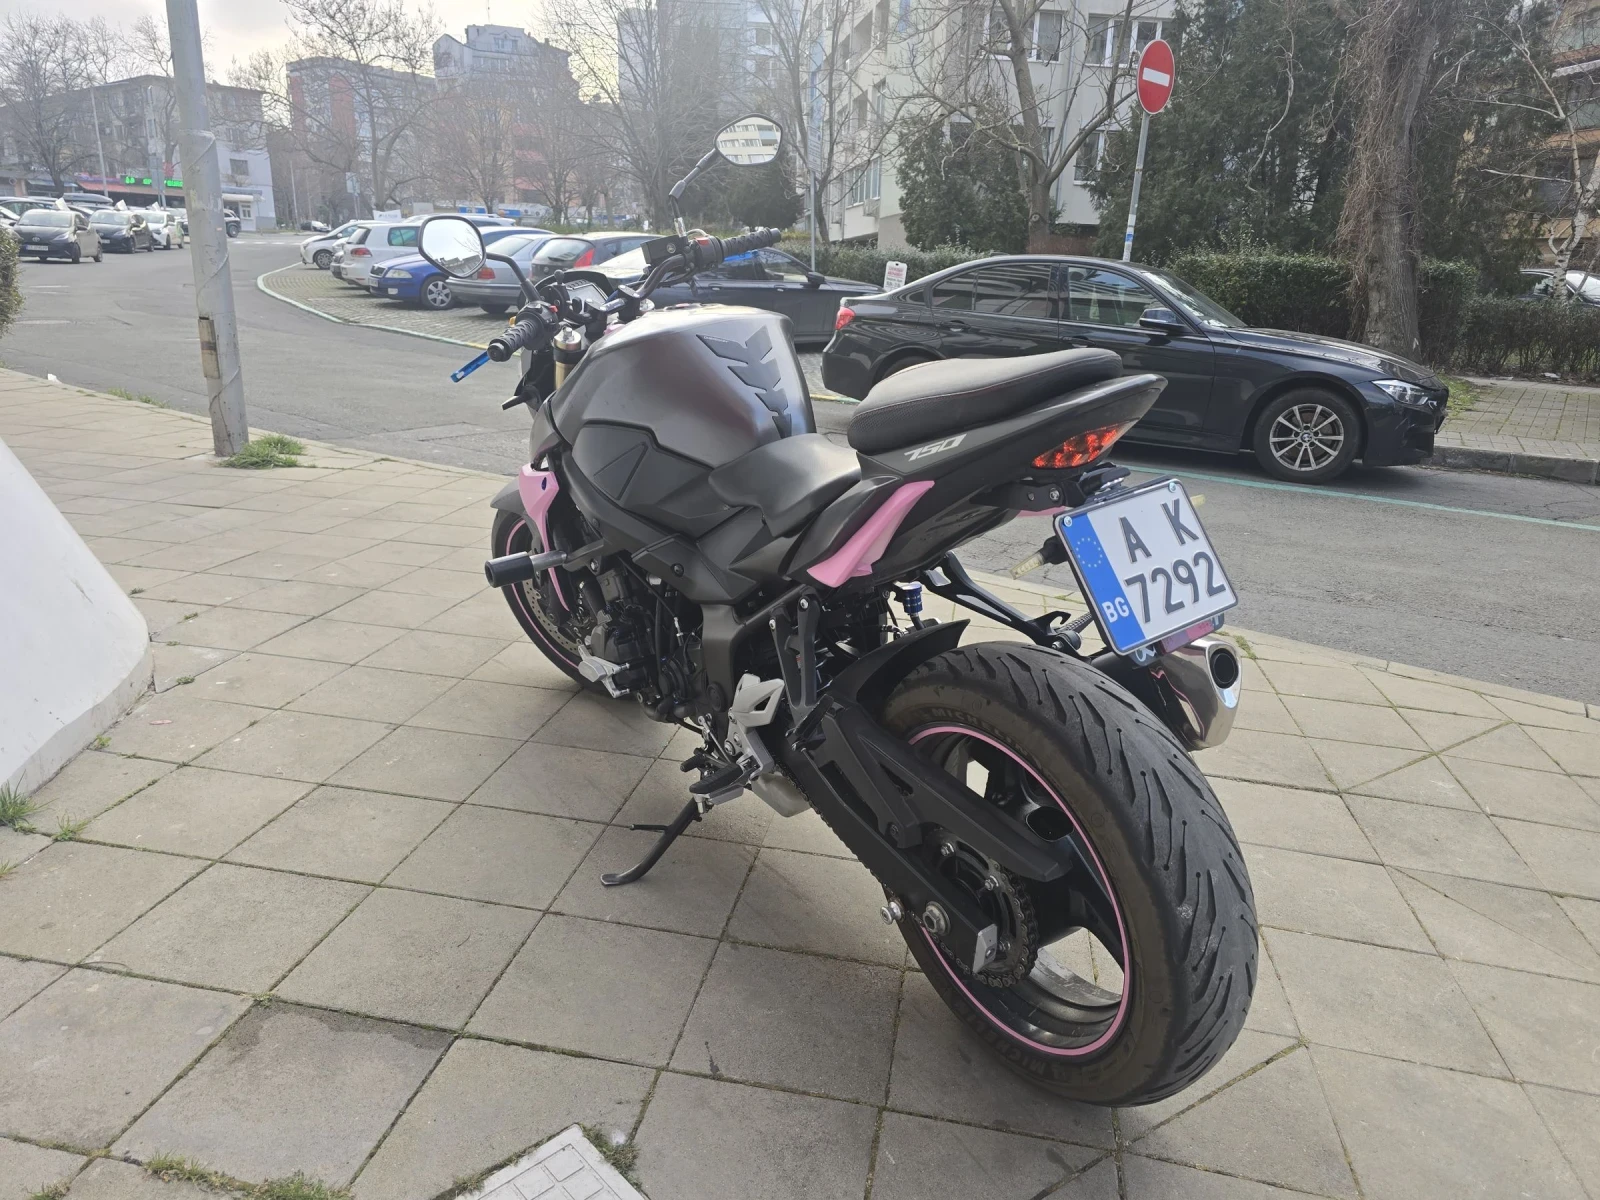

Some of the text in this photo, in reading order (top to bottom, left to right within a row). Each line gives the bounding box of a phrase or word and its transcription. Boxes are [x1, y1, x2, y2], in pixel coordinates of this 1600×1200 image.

[904, 433, 967, 461] 750
[1119, 498, 1199, 563] A K
[1102, 597, 1130, 623] BG
[1124, 551, 1227, 624] 7292
